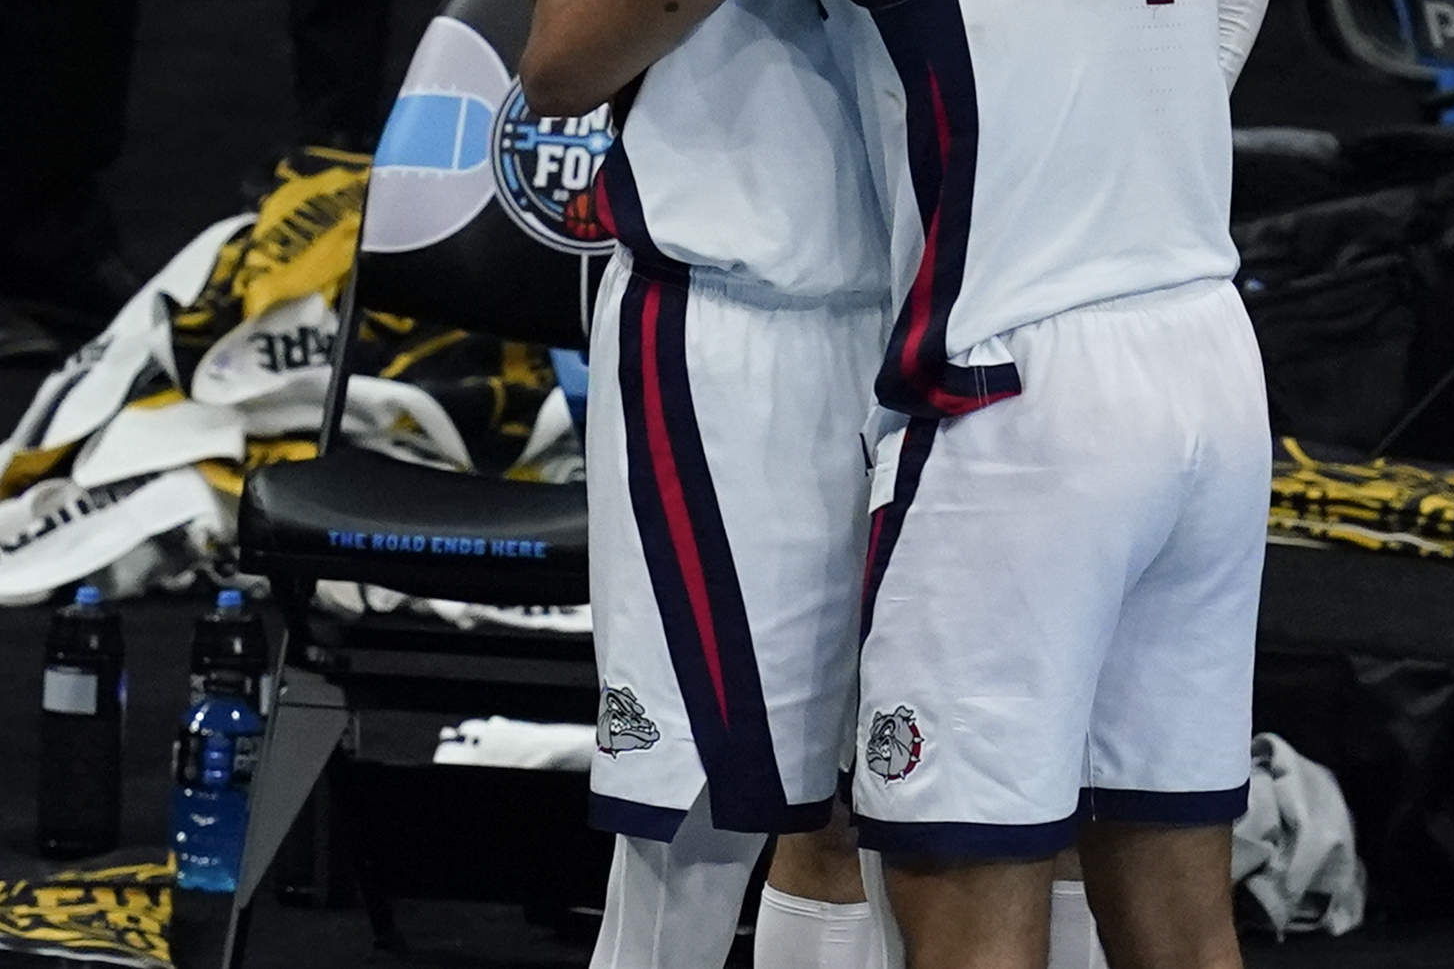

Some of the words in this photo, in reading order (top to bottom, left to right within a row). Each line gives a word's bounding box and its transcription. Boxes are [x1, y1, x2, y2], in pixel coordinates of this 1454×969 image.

[328, 531, 366, 550] THE
[371, 533, 426, 552] ROAD
[431, 536, 487, 555] ENDS
[491, 539, 548, 559] HERE
